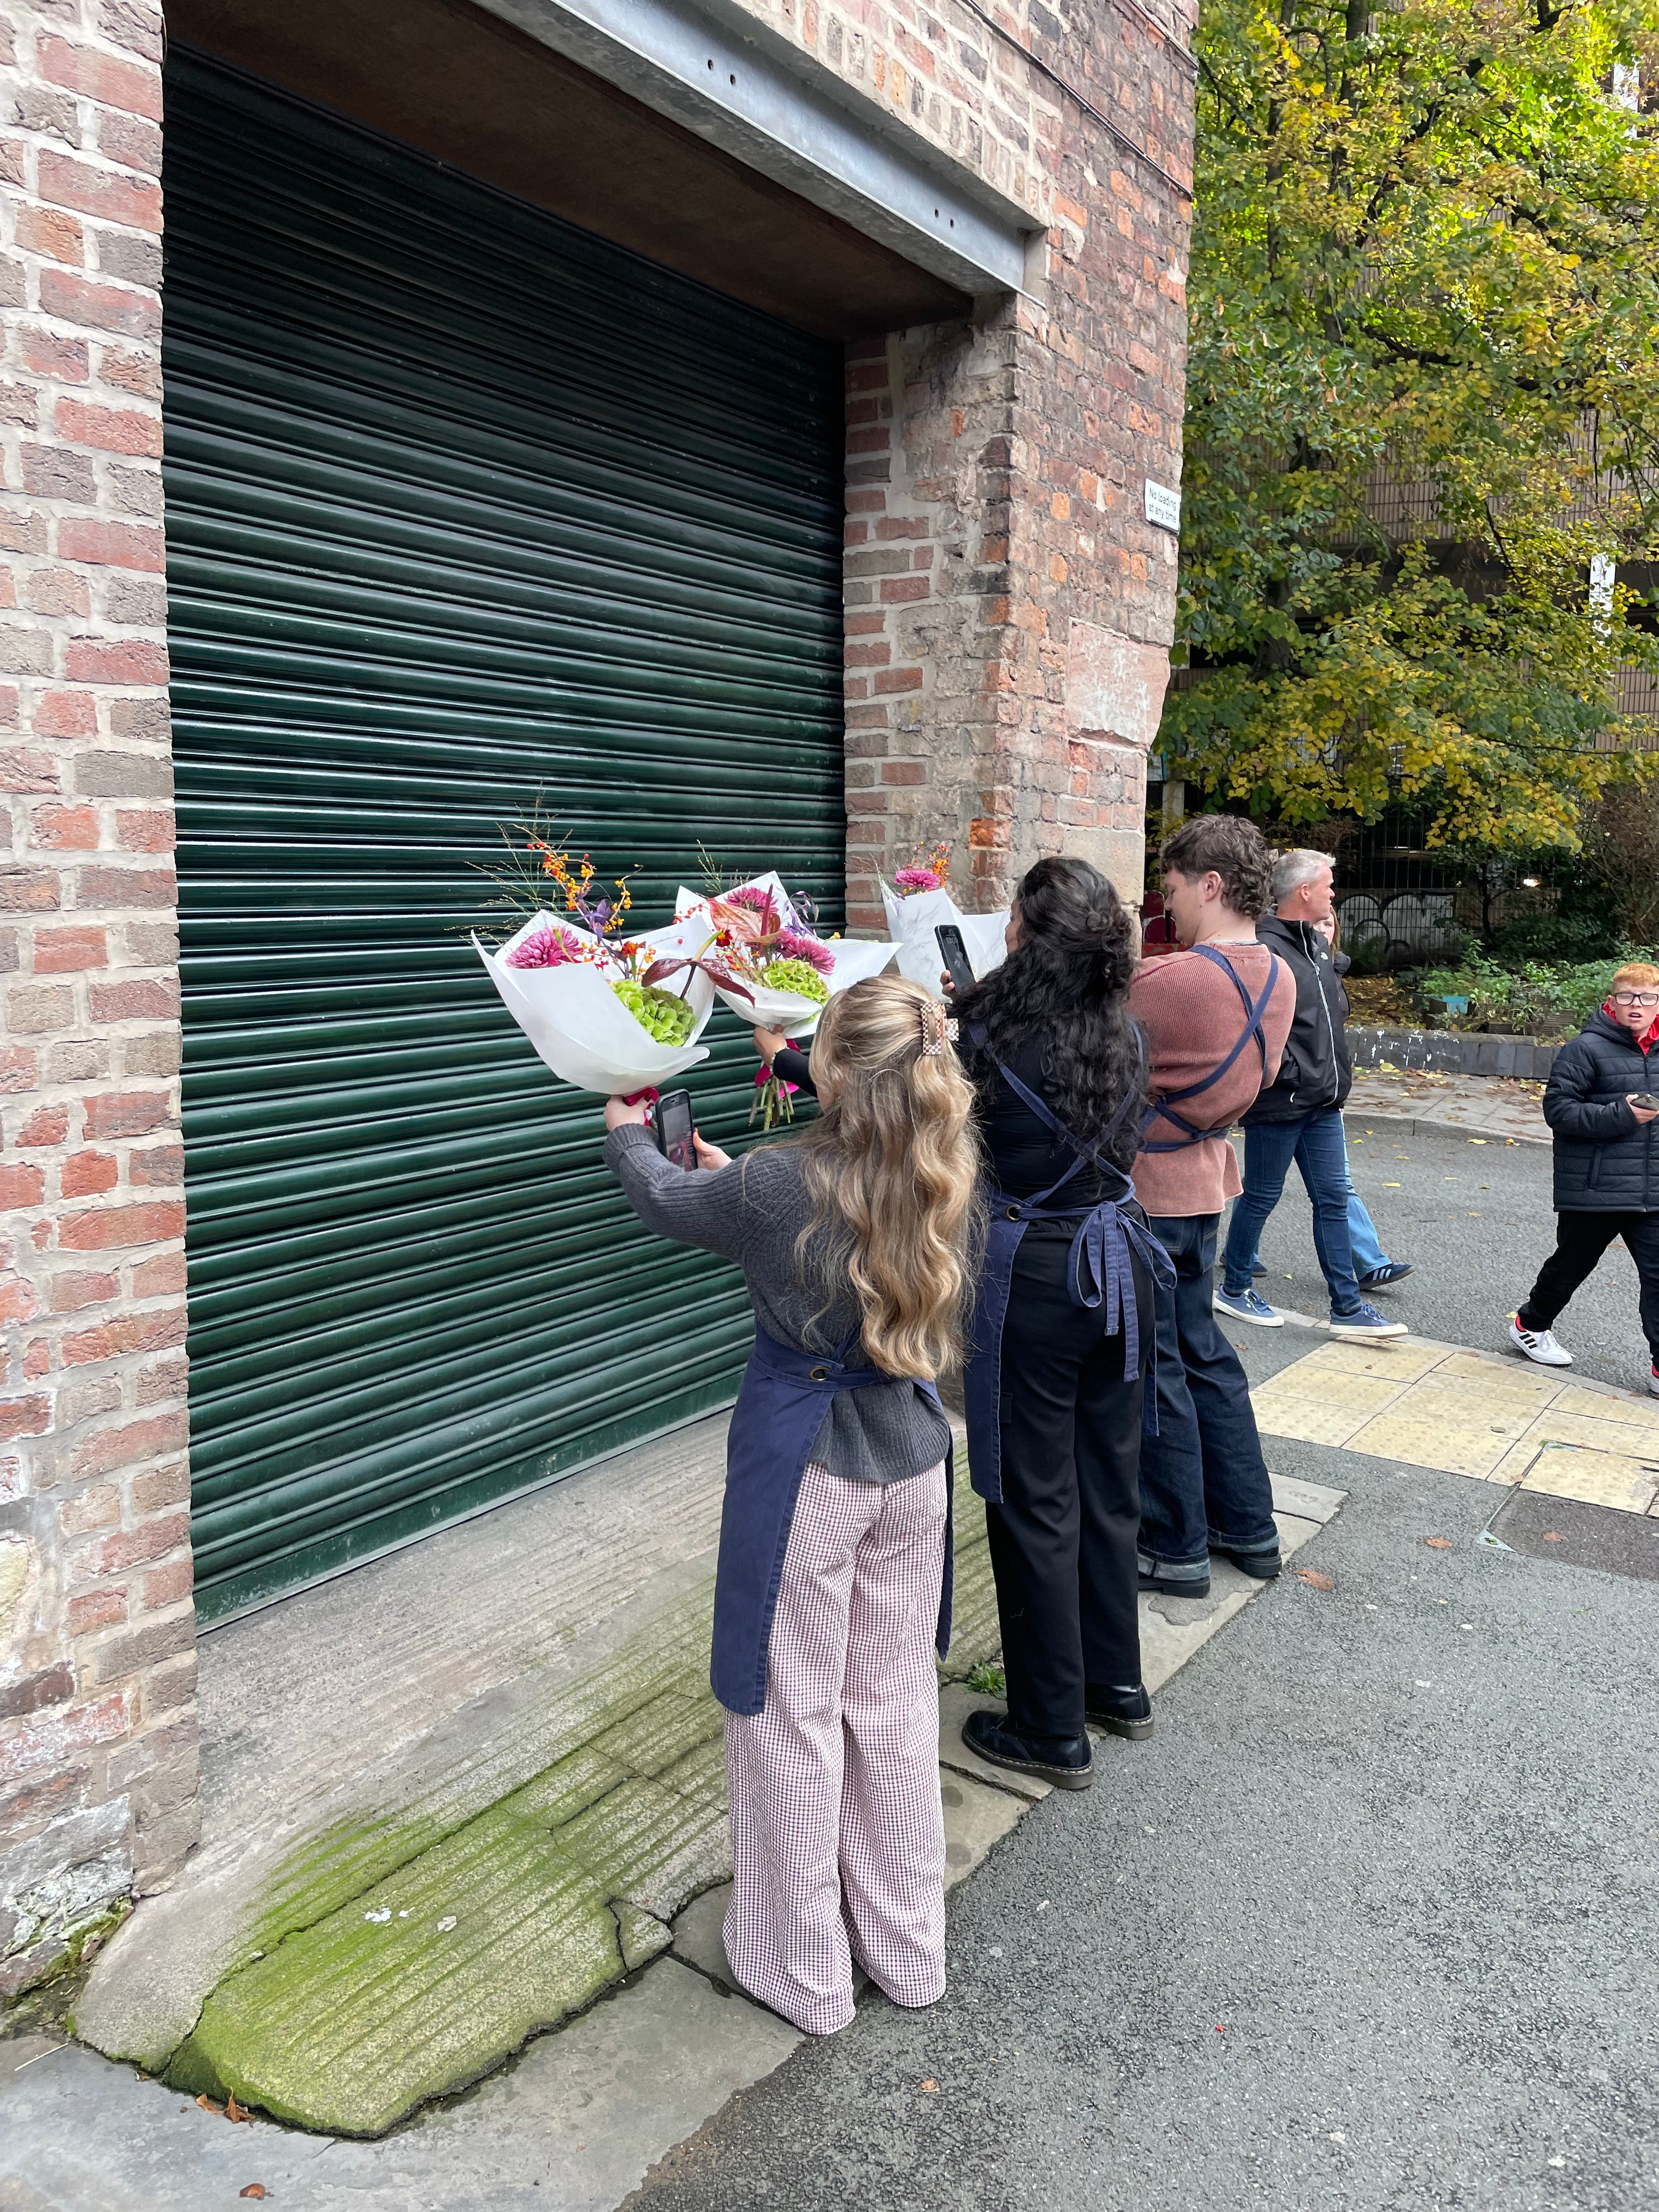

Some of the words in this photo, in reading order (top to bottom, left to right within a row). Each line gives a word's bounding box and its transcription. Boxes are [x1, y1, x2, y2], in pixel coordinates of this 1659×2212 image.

[1150, 487, 1156, 499] No
[1159, 492, 1176, 511] loading
[1149, 503, 1154, 513] at
[1155, 507, 1164, 519] any
[1166, 509, 1176, 523] time
